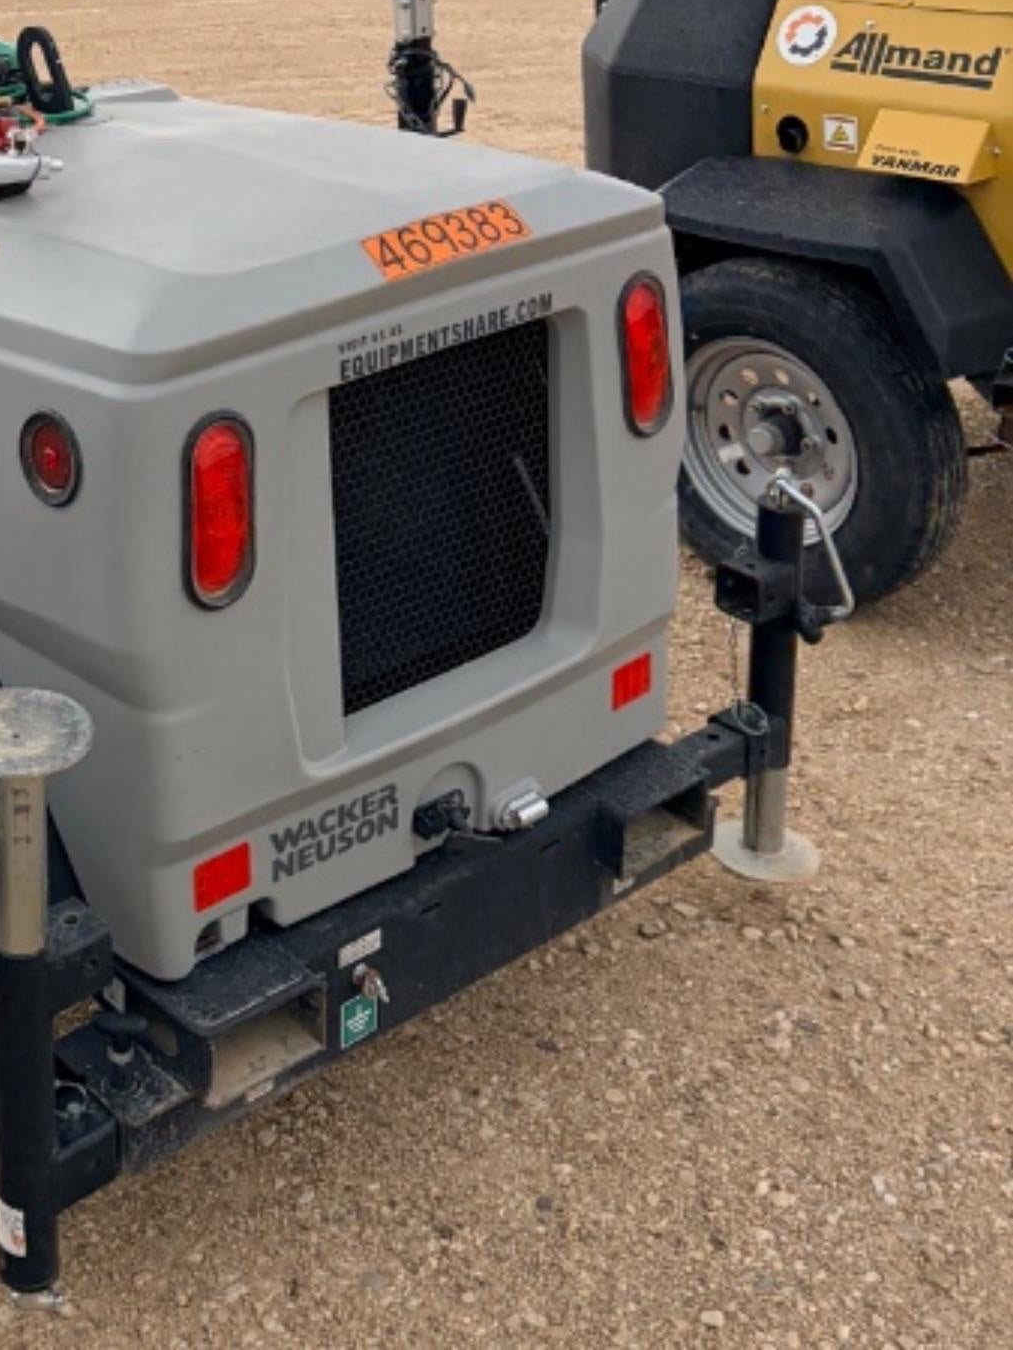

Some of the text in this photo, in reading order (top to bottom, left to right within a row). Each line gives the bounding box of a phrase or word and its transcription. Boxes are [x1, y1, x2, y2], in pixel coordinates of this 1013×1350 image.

[830, 33, 1002, 77] Allmand
[872, 153, 960, 178] YANMAR
[378, 201, 524, 270] 469383
[340, 291, 553, 382] EQUIPMENTSHARE.COM
[269, 782, 399, 853] WACKER
[271, 807, 400, 883] NEUSON
